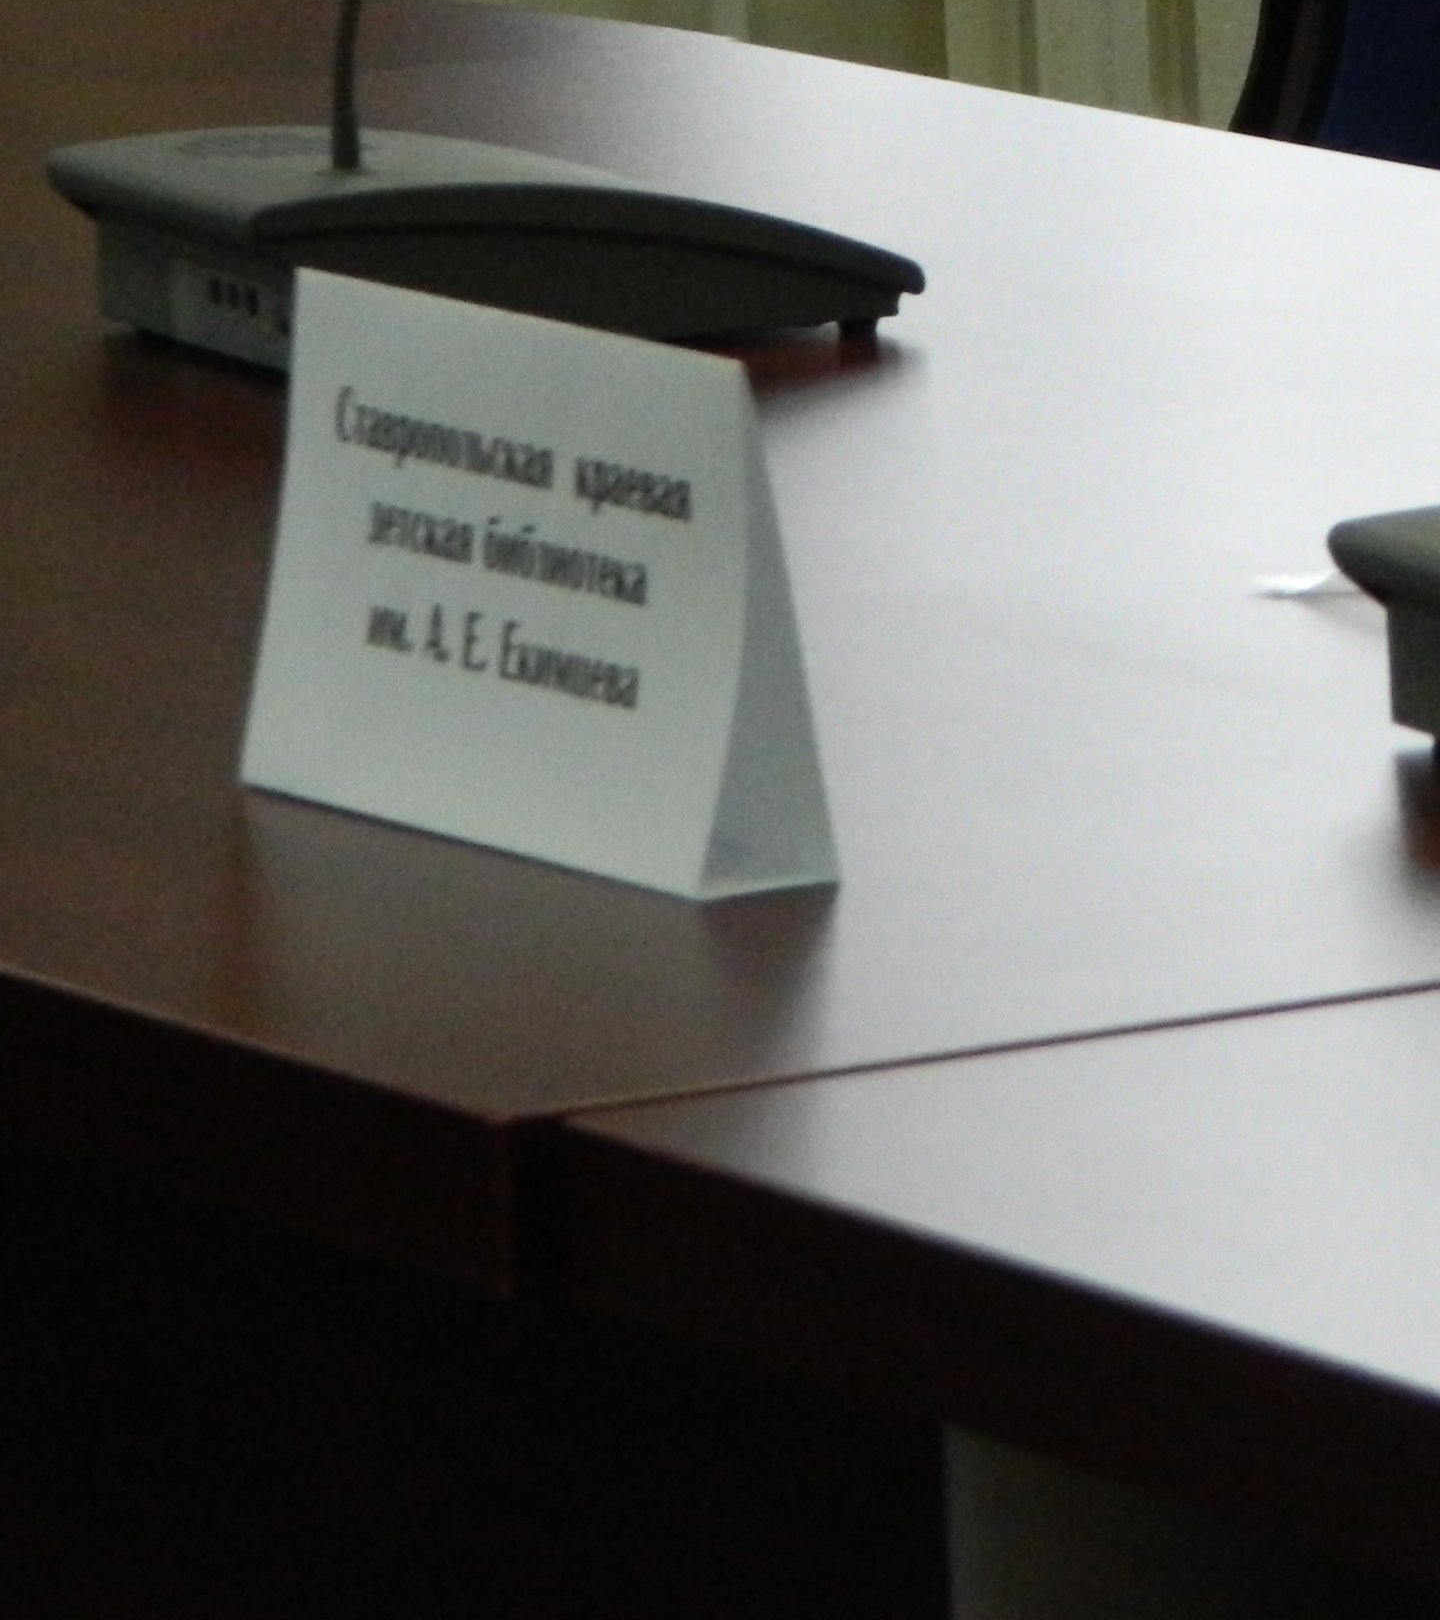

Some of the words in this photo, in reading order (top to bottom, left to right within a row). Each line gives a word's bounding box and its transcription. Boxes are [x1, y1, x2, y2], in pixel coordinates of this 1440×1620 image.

[574, 457, 692, 523] краевая
[368, 501, 473, 564] детская
[484, 515, 648, 607] библиотека
